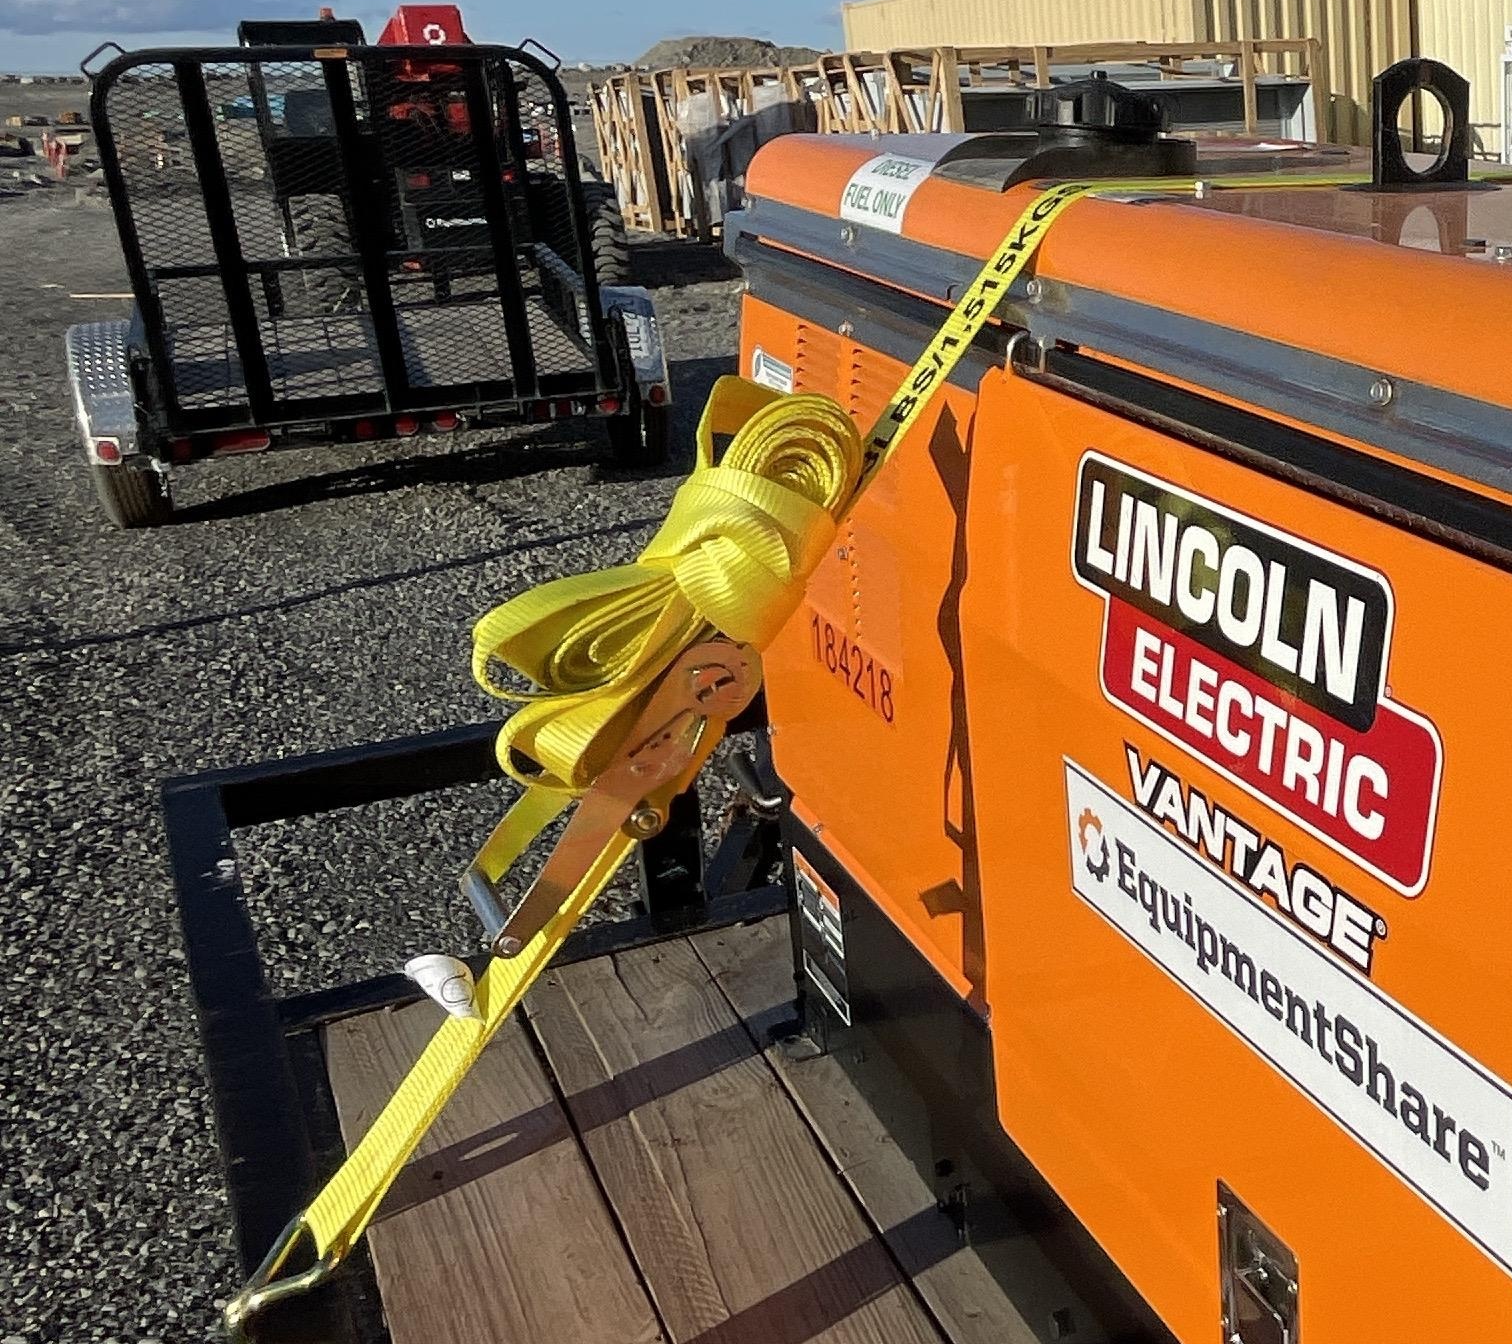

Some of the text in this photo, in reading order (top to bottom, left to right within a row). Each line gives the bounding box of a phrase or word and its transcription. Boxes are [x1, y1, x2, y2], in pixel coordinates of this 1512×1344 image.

[844, 183, 907, 218] FUEL ONLY
[812, 613, 895, 724] 184218
[1087, 479, 1366, 706] LINCOLN
[1129, 628, 1388, 842] ELECTRIC
[1126, 747, 1373, 973] VANTAGE
[1113, 837, 1492, 1192] EquipmentShare
